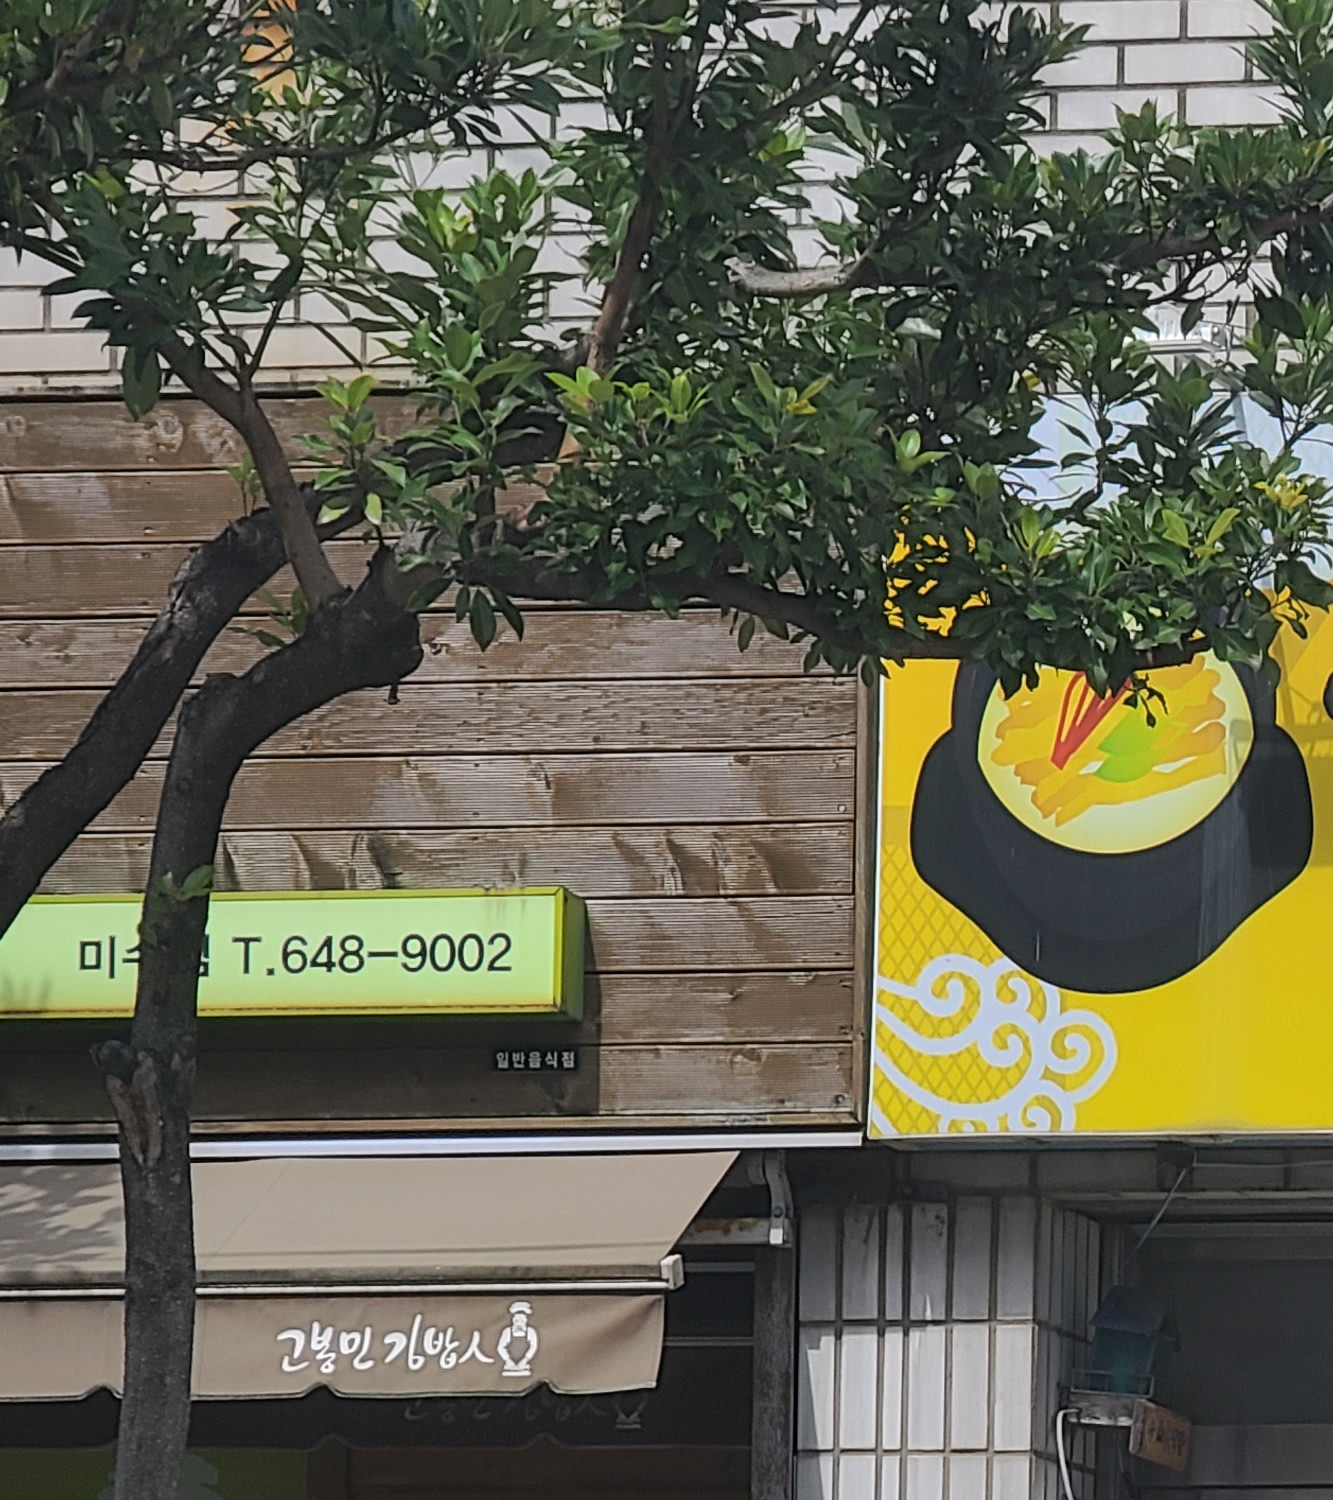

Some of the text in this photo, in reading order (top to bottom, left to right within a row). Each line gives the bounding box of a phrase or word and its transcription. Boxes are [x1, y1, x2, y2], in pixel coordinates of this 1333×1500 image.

[232, 933, 512, 976] T.648-9002
[495, 1050, 575, 1069] 일반음식점
[276, 1320, 375, 1374] 고봉민
